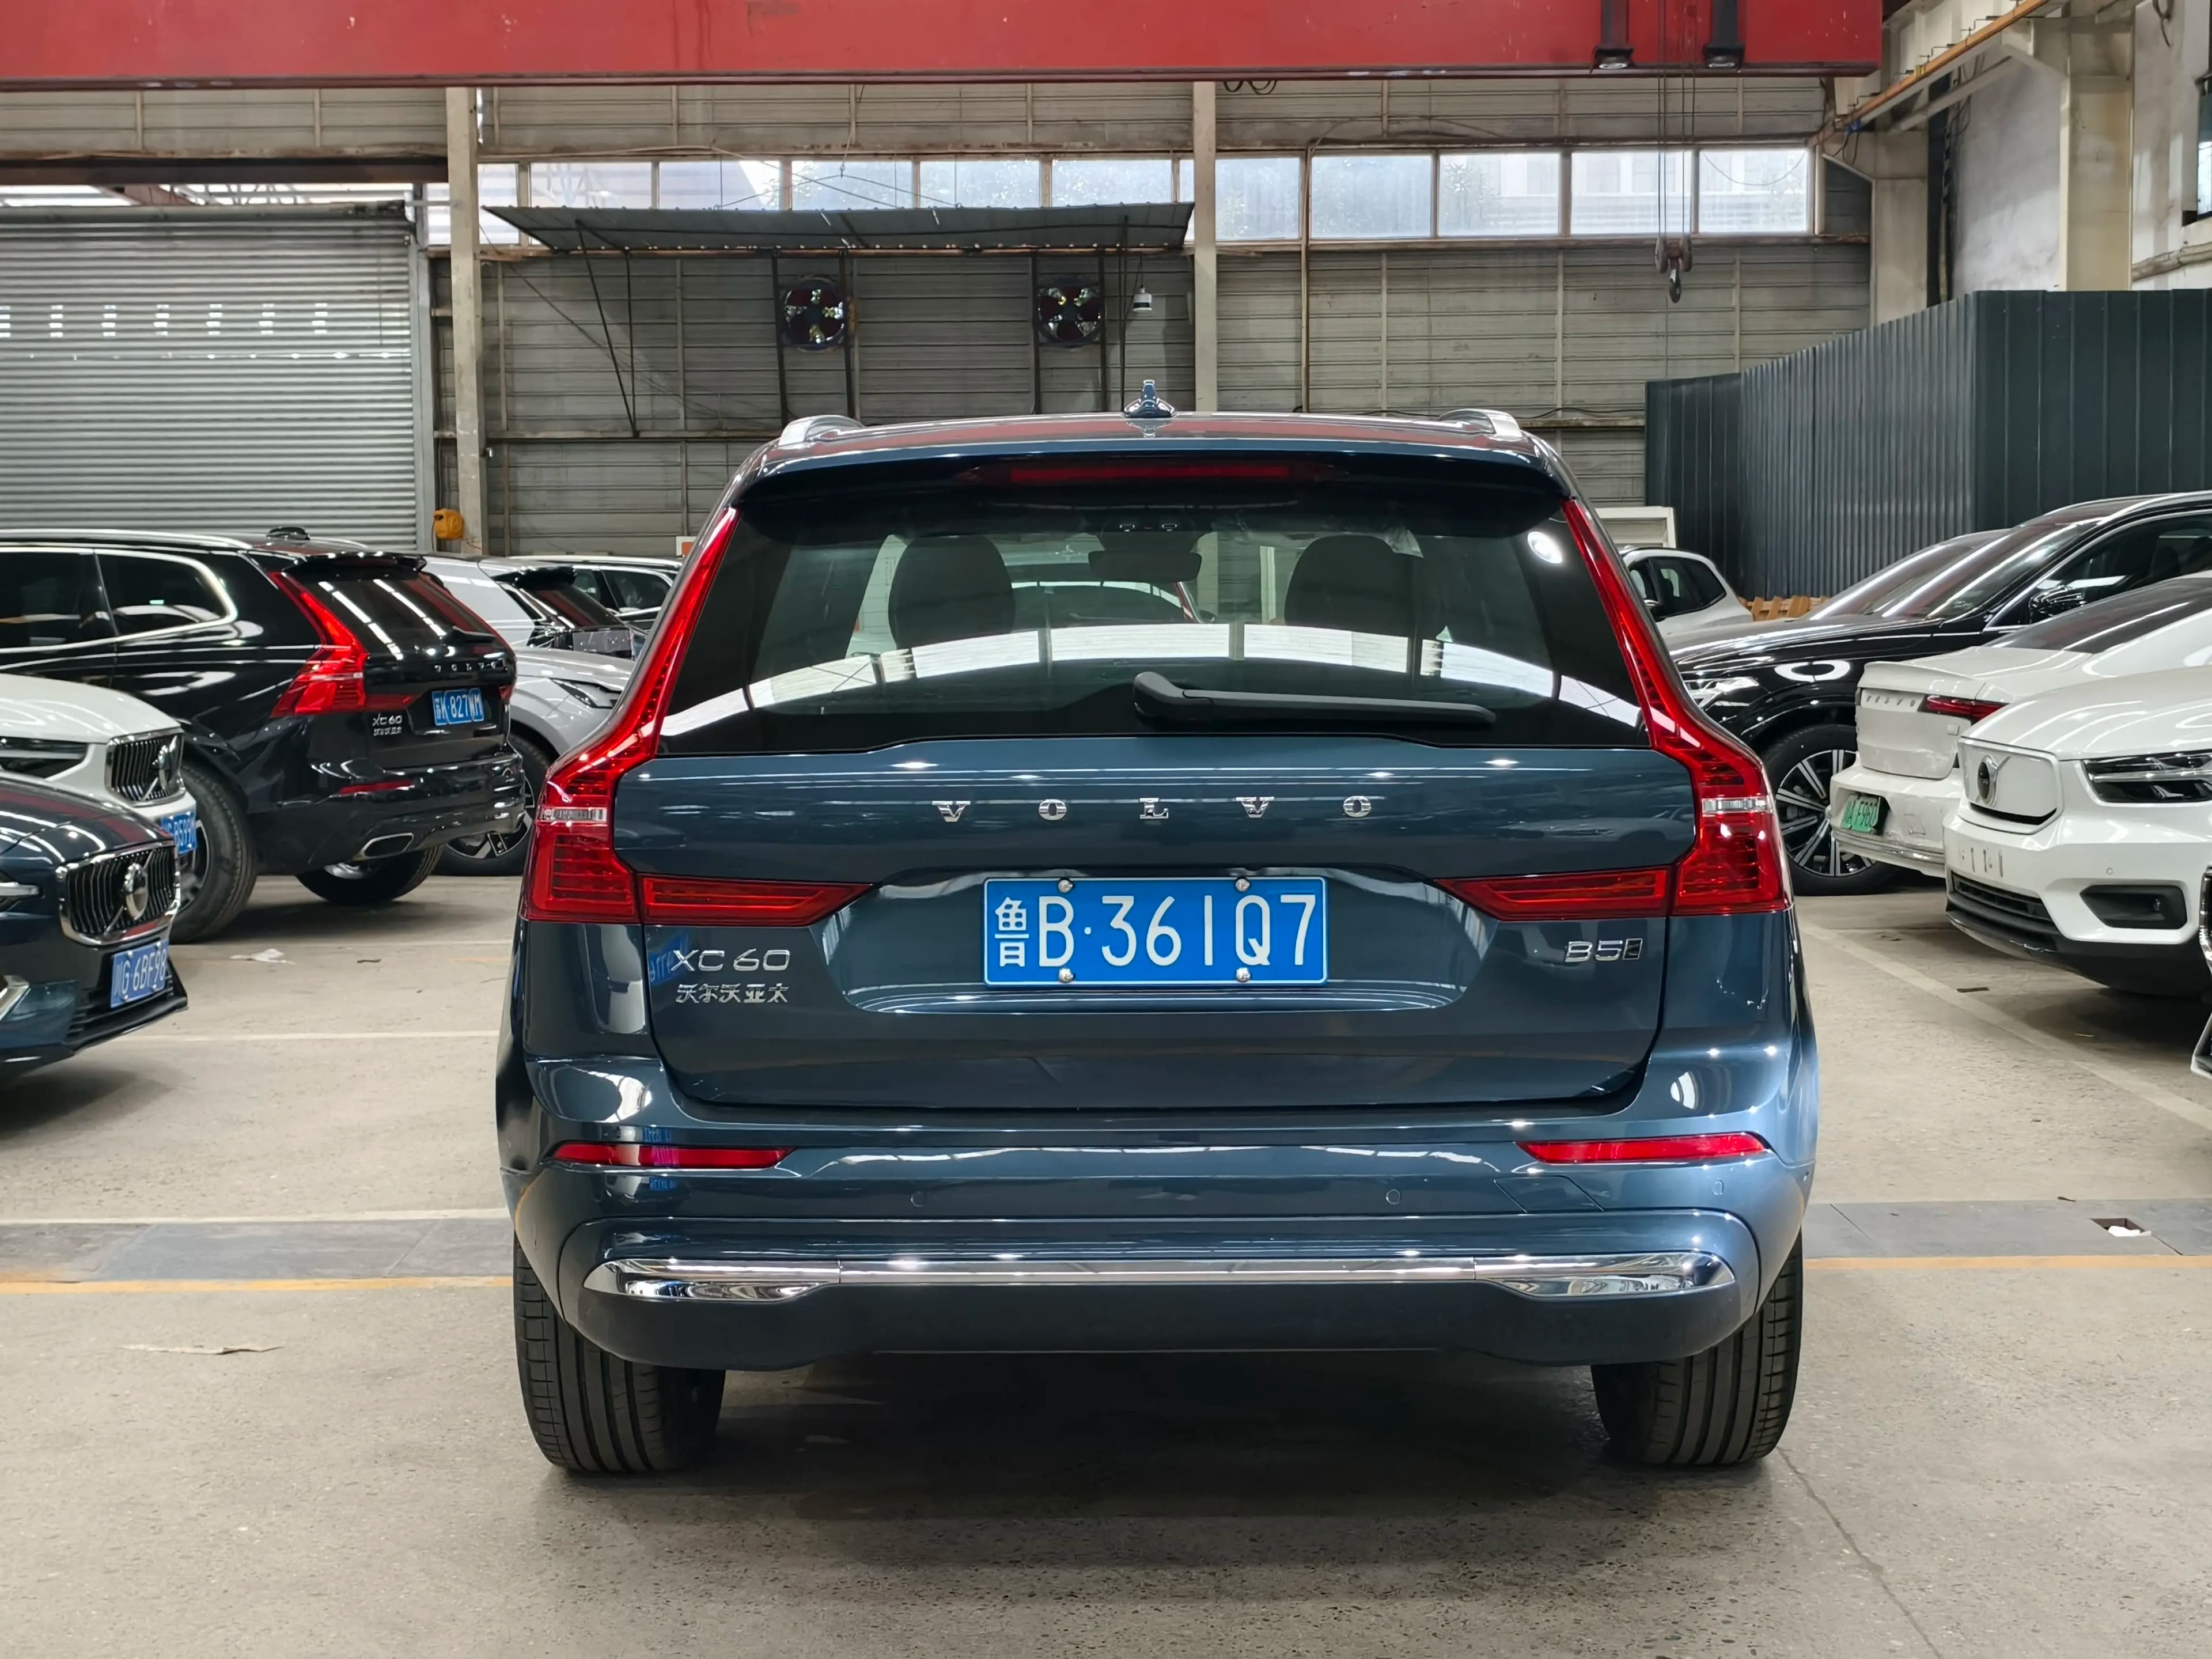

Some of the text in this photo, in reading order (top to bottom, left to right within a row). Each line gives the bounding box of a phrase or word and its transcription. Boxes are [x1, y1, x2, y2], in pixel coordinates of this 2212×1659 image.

[931, 796, 1372, 823] VOLVO
[994, 894, 1316, 968] 鲁B·361Q7
[670, 948, 791, 971] XC60
[675, 983, 789, 1003] 沃尔沃亚太
